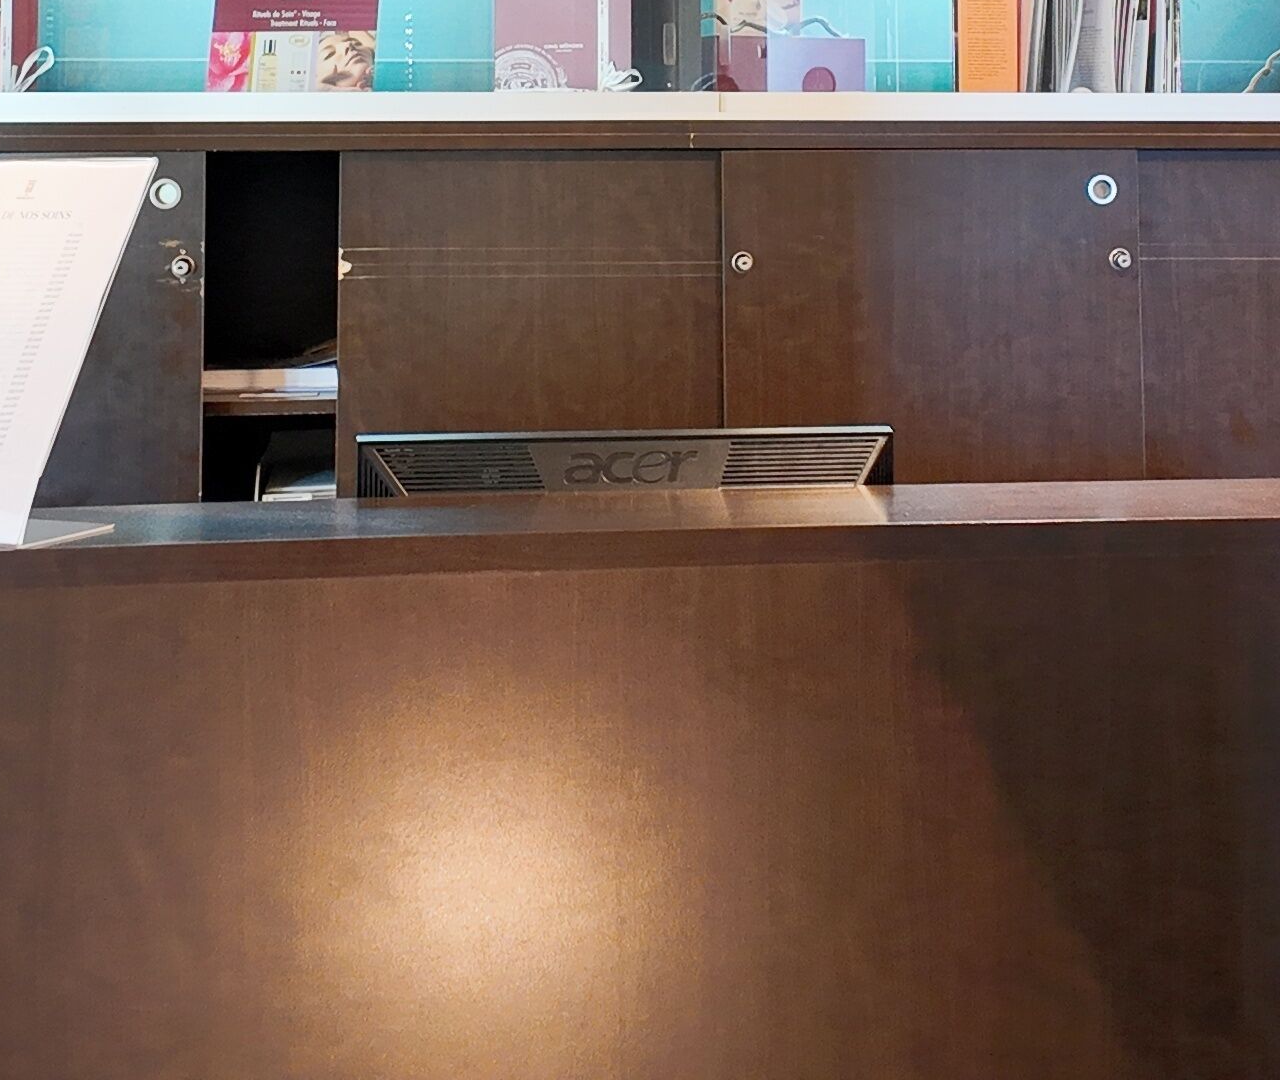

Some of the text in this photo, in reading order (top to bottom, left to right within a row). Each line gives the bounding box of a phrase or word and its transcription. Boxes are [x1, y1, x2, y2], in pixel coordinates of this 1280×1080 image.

[272, 10, 280, 18] de
[18, 210, 40, 221] NOS
[41, 210, 74, 221] SOINS
[564, 450, 699, 485] acer
